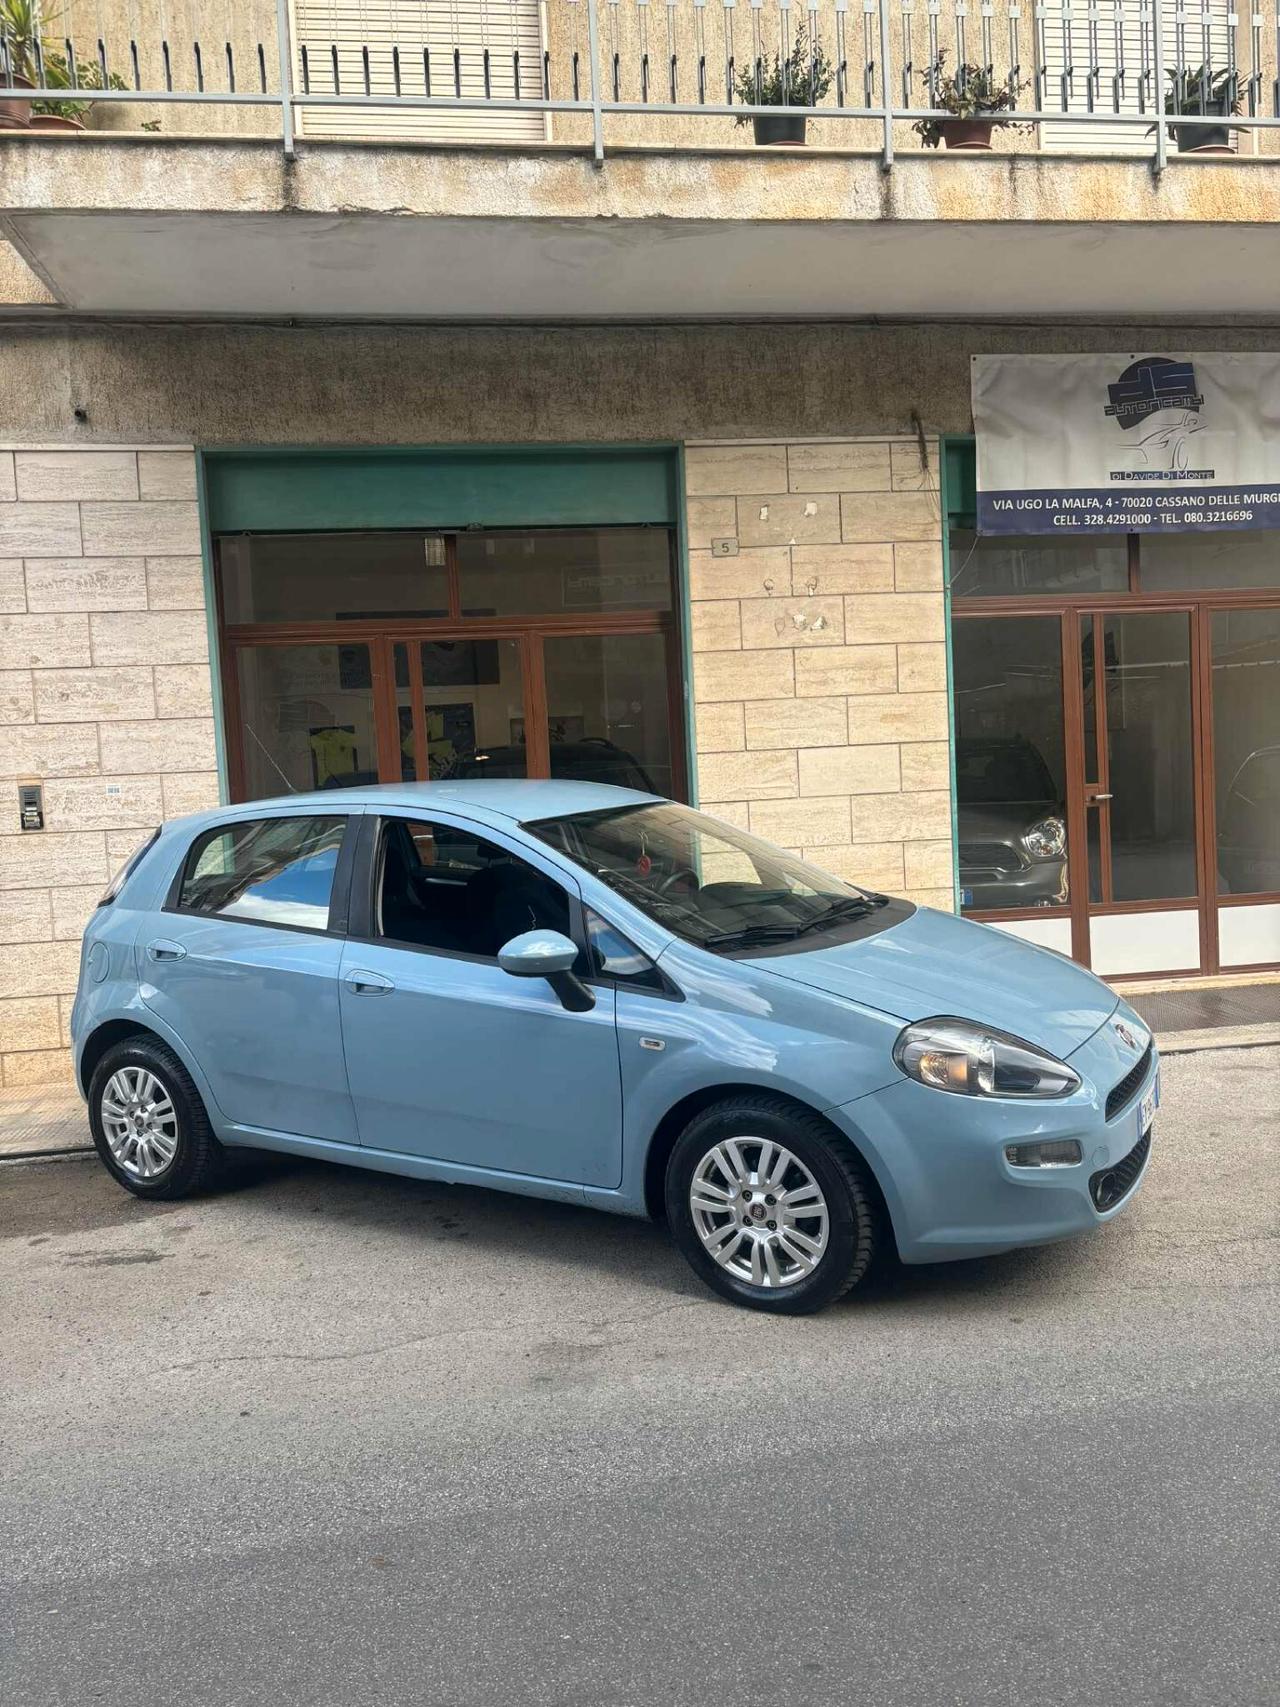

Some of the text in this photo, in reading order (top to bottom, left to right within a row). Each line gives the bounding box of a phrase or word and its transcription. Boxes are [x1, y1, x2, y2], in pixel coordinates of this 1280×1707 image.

[993, 499, 1014, 510] VIA
[1016, 499, 1043, 510] UGO
[1045, 499, 1059, 509] LA
[1062, 498, 1103, 510] MALFA,
[1105, 497, 1113, 507] 4
[1121, 496, 1153, 508] 70020
[1155, 495, 1205, 507] CASSANO
[1208, 494, 1241, 505] DELLE
[1053, 514, 1081, 525] CELL.
[1084, 513, 1151, 525] 328.4291000
[1160, 513, 1181, 523] TEL.
[1184, 510, 1253, 523] 080.3216696
[721, 542, 730, 553] 5
